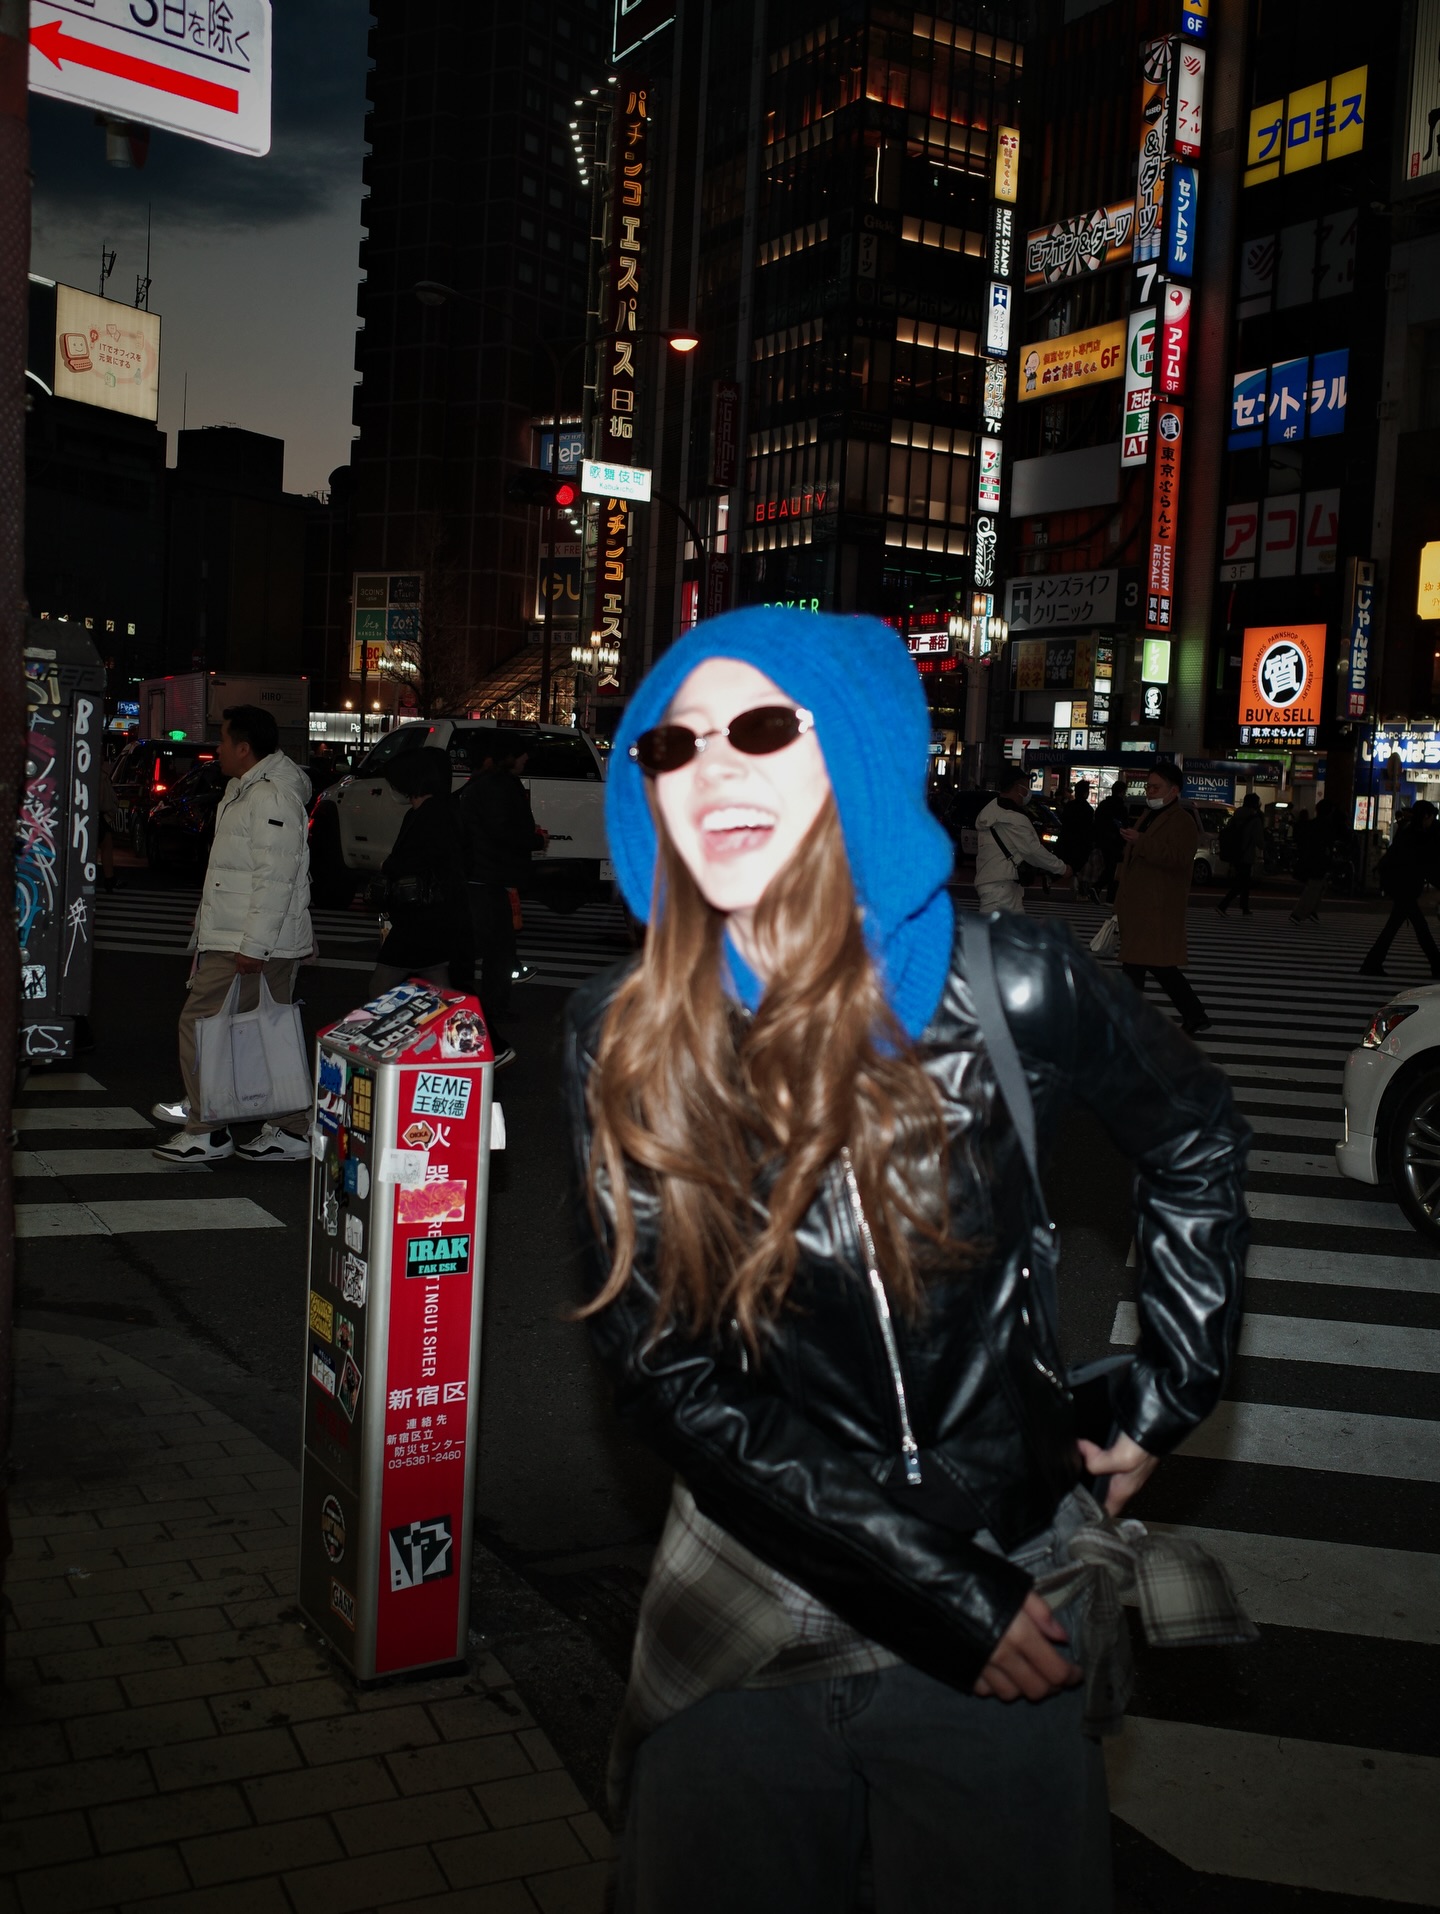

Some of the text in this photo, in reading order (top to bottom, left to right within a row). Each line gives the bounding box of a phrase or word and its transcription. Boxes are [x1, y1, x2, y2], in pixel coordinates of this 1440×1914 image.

[1187, 16, 1203, 32] 6F
[1257, 94, 1364, 159] プロミス
[623, 90, 647, 208] パチンコ
[1181, 143, 1192, 155] 5F
[1002, 188, 1012, 196] 6F
[1174, 178, 1192, 264] セントラル
[863, 235, 874, 274] ダーツ
[1000, 208, 1012, 276] BUZZ STAND
[992, 240, 1001, 275] KARAOKE
[612, 215, 642, 379] エスパス
[992, 308, 1000, 341] クリニック
[998, 310, 1006, 348] メンズライフ
[99, 342, 142, 362] ITでオフィスを
[99, 353, 131, 368] 元気にする
[1101, 344, 1121, 369] 6F
[1166, 326, 1183, 378] アコム
[1166, 380, 1179, 391] 3F
[1233, 375, 1348, 427] セントラル
[985, 417, 1002, 434] 7F
[1161, 416, 1178, 437] 質
[1283, 425, 1298, 440] 4F
[720, 402, 735, 480] GAME
[1126, 435, 1148, 456] AT
[590, 465, 645, 486] 歌舞伎町
[755, 491, 828, 523] BEAUTY
[982, 492, 996, 500] ATM
[1224, 503, 1340, 558] アコム
[544, 545, 581, 555] TX FRE
[1151, 543, 1162, 589] RESALE
[1161, 544, 1172, 591] LUXURY
[1230, 565, 1247, 579] 3F
[360, 588, 384, 597] 3COINS
[541, 572, 581, 601] GU
[1034, 575, 1110, 600] メンズライフ
[1033, 601, 1094, 625] クリニック
[1267, 630, 1299, 644] PAWNSHOP
[1150, 642, 1161, 677] レイク
[1252, 643, 1267, 672] BRANDS
[1299, 639, 1314, 669] WATCHES
[1263, 648, 1300, 702] 質
[1301, 670, 1315, 702] JEWELRY
[261, 692, 282, 701] HIRO
[1028, 753, 1067, 762] SUBNADE
[1186, 775, 1229, 787] SUBNADE
[417, 1073, 471, 1097] XEME
[408, 1236, 469, 1262] IRAK
[418, 1261, 457, 1274] FAK ESK
[420, 1274, 440, 1378] TINGUISHER
[387, 1380, 468, 1411] 新宿区
[405, 1414, 448, 1431] 連絡先
[386, 1428, 435, 1446] 新宿区立
[394, 1439, 466, 1458] 防災センター
[388, 1449, 462, 1470] 03-5361-2460
